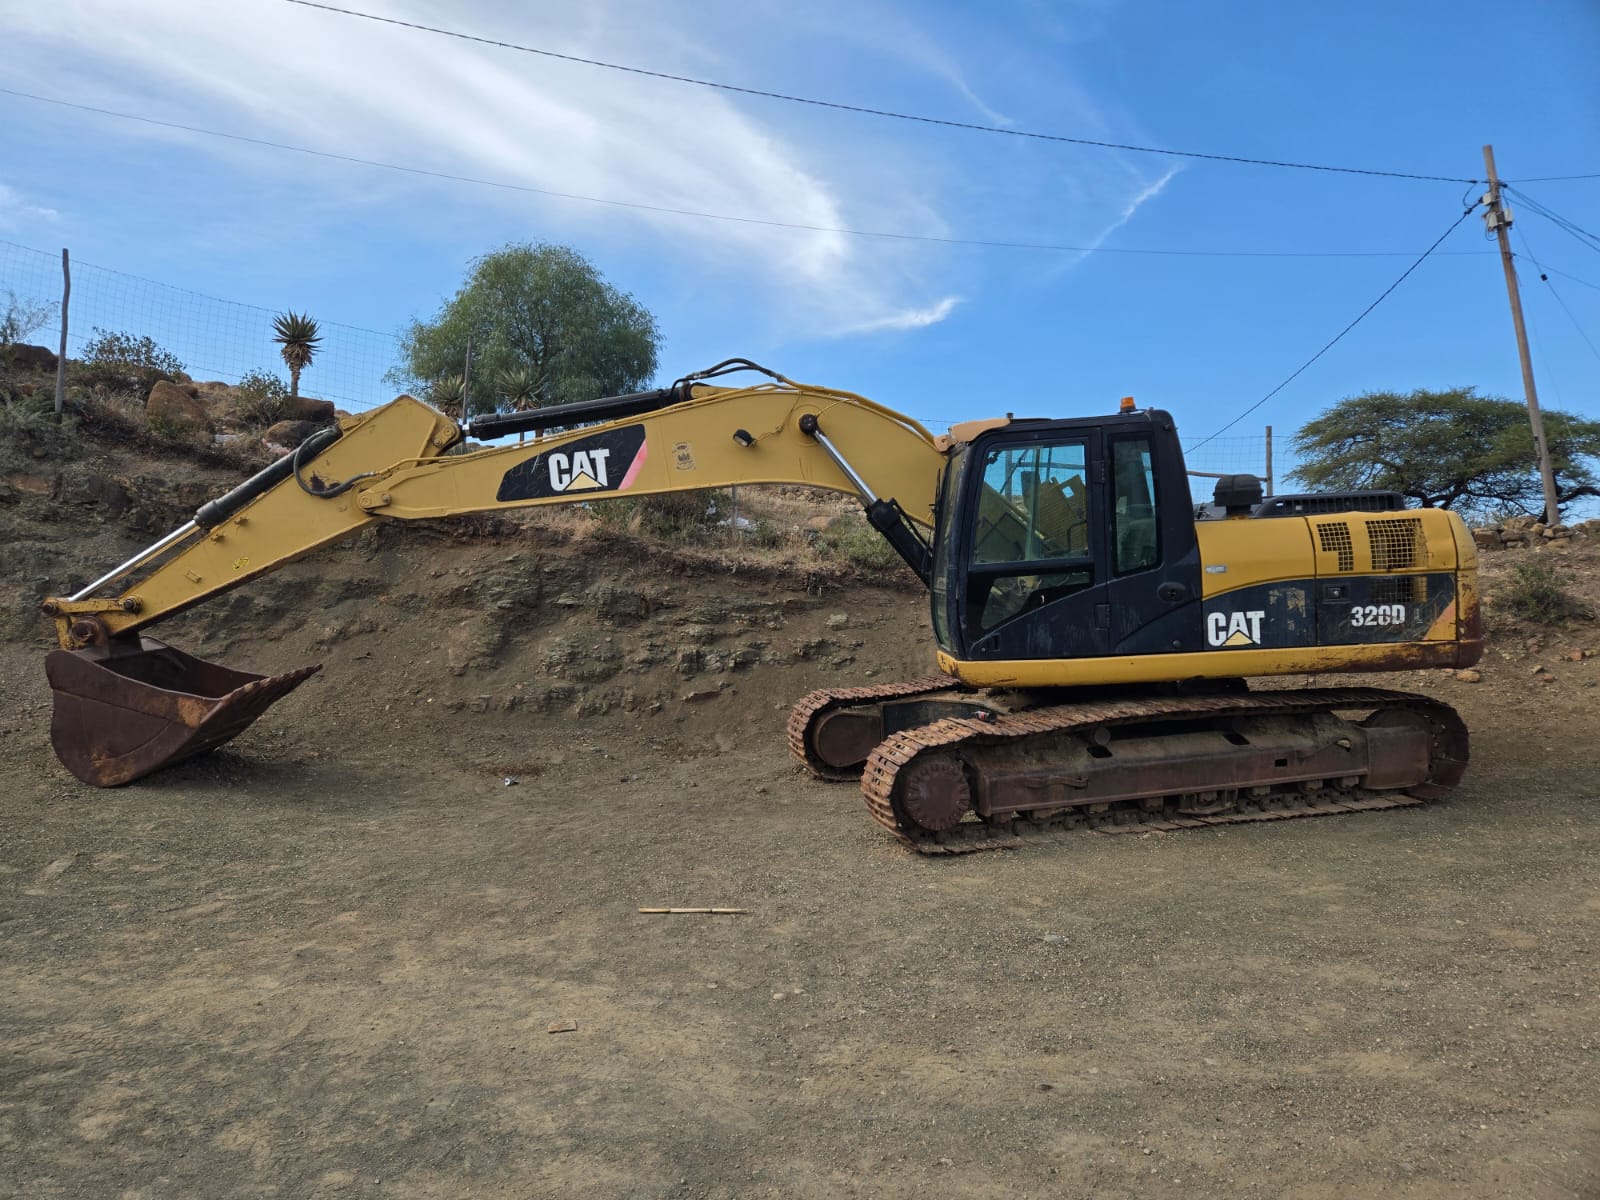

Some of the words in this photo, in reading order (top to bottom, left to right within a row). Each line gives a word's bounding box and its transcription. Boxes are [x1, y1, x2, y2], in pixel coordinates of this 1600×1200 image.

[548, 448, 610, 491] CAT
[1207, 610, 1265, 647] CAT
[1351, 604, 1406, 627] 320D
